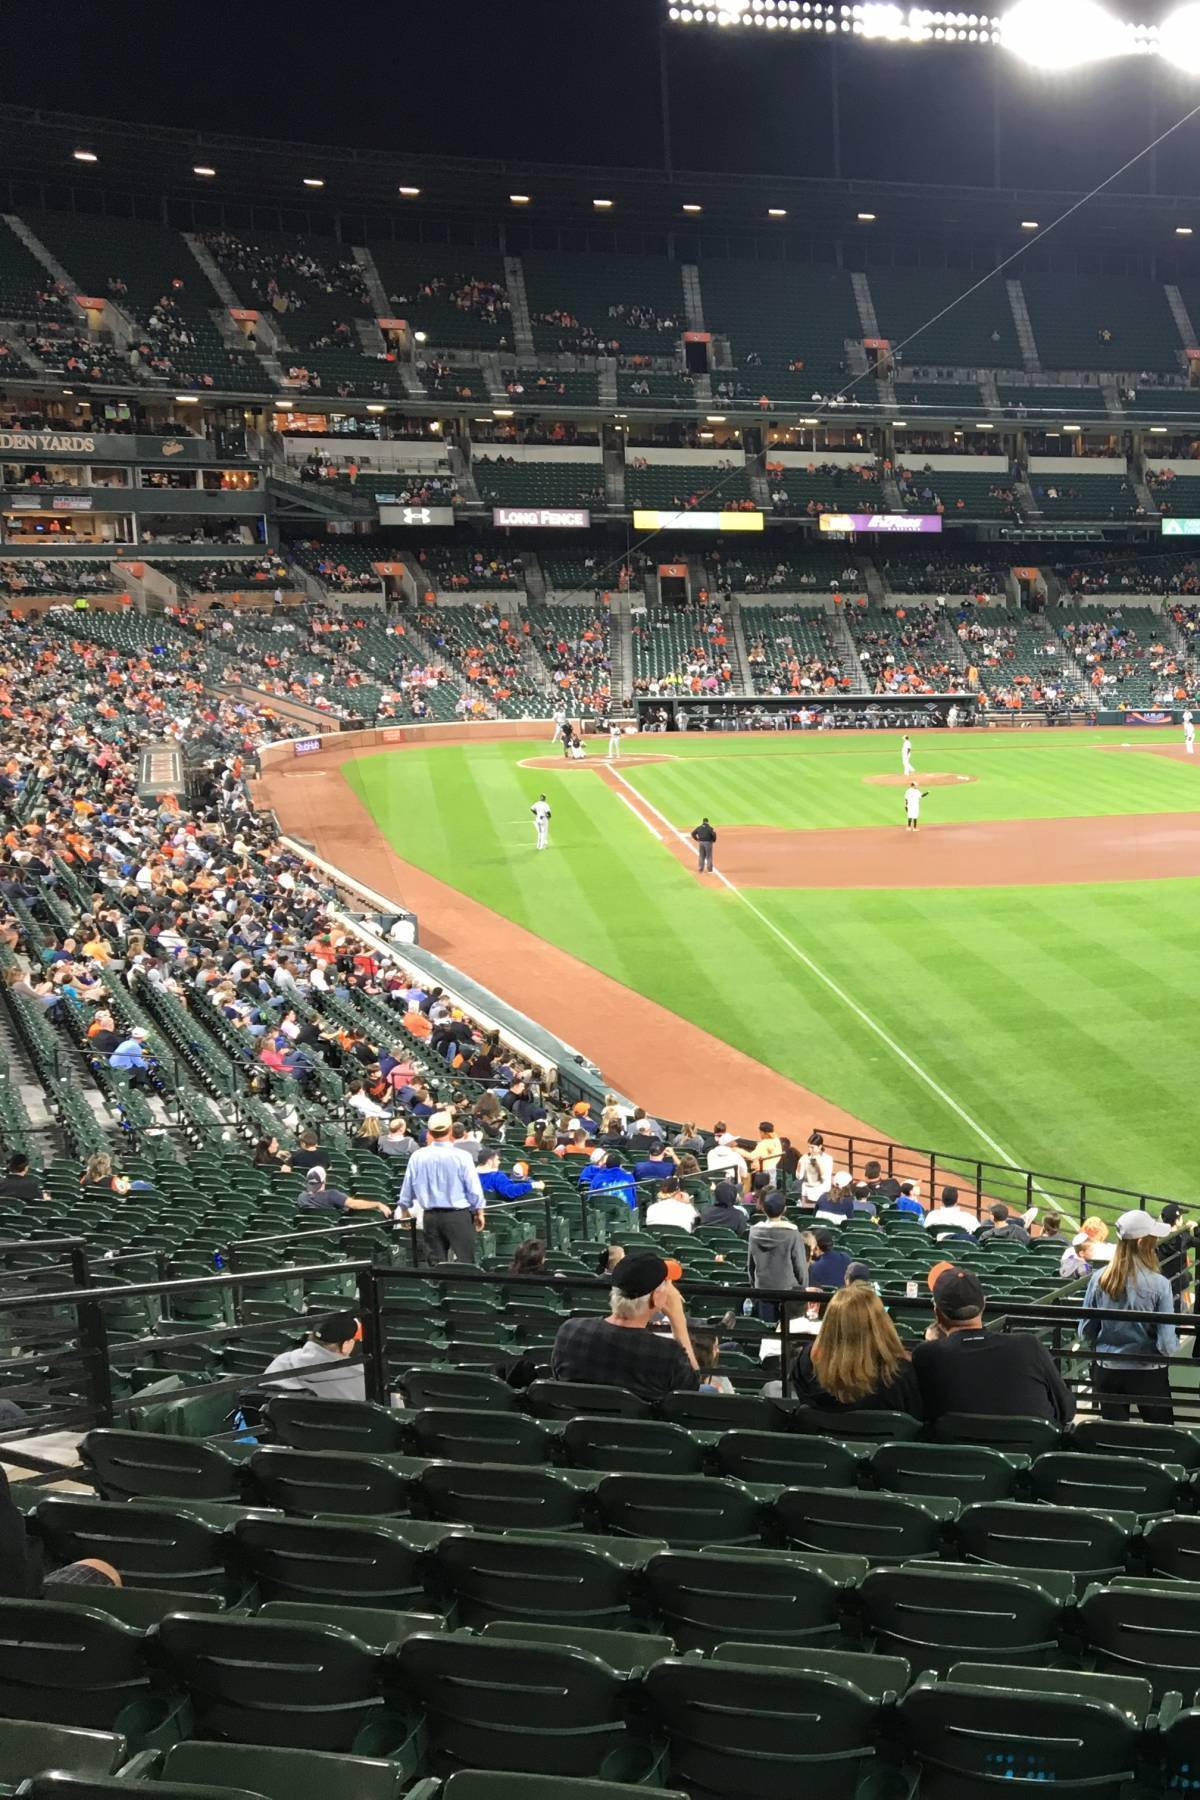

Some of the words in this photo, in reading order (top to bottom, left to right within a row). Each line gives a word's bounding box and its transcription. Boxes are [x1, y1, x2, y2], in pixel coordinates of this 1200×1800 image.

[38, 435, 95, 452] YARDS
[499, 509, 539, 525] LONG
[540, 510, 584, 526] FENCE
[295, 739, 320, 753] StubHub
